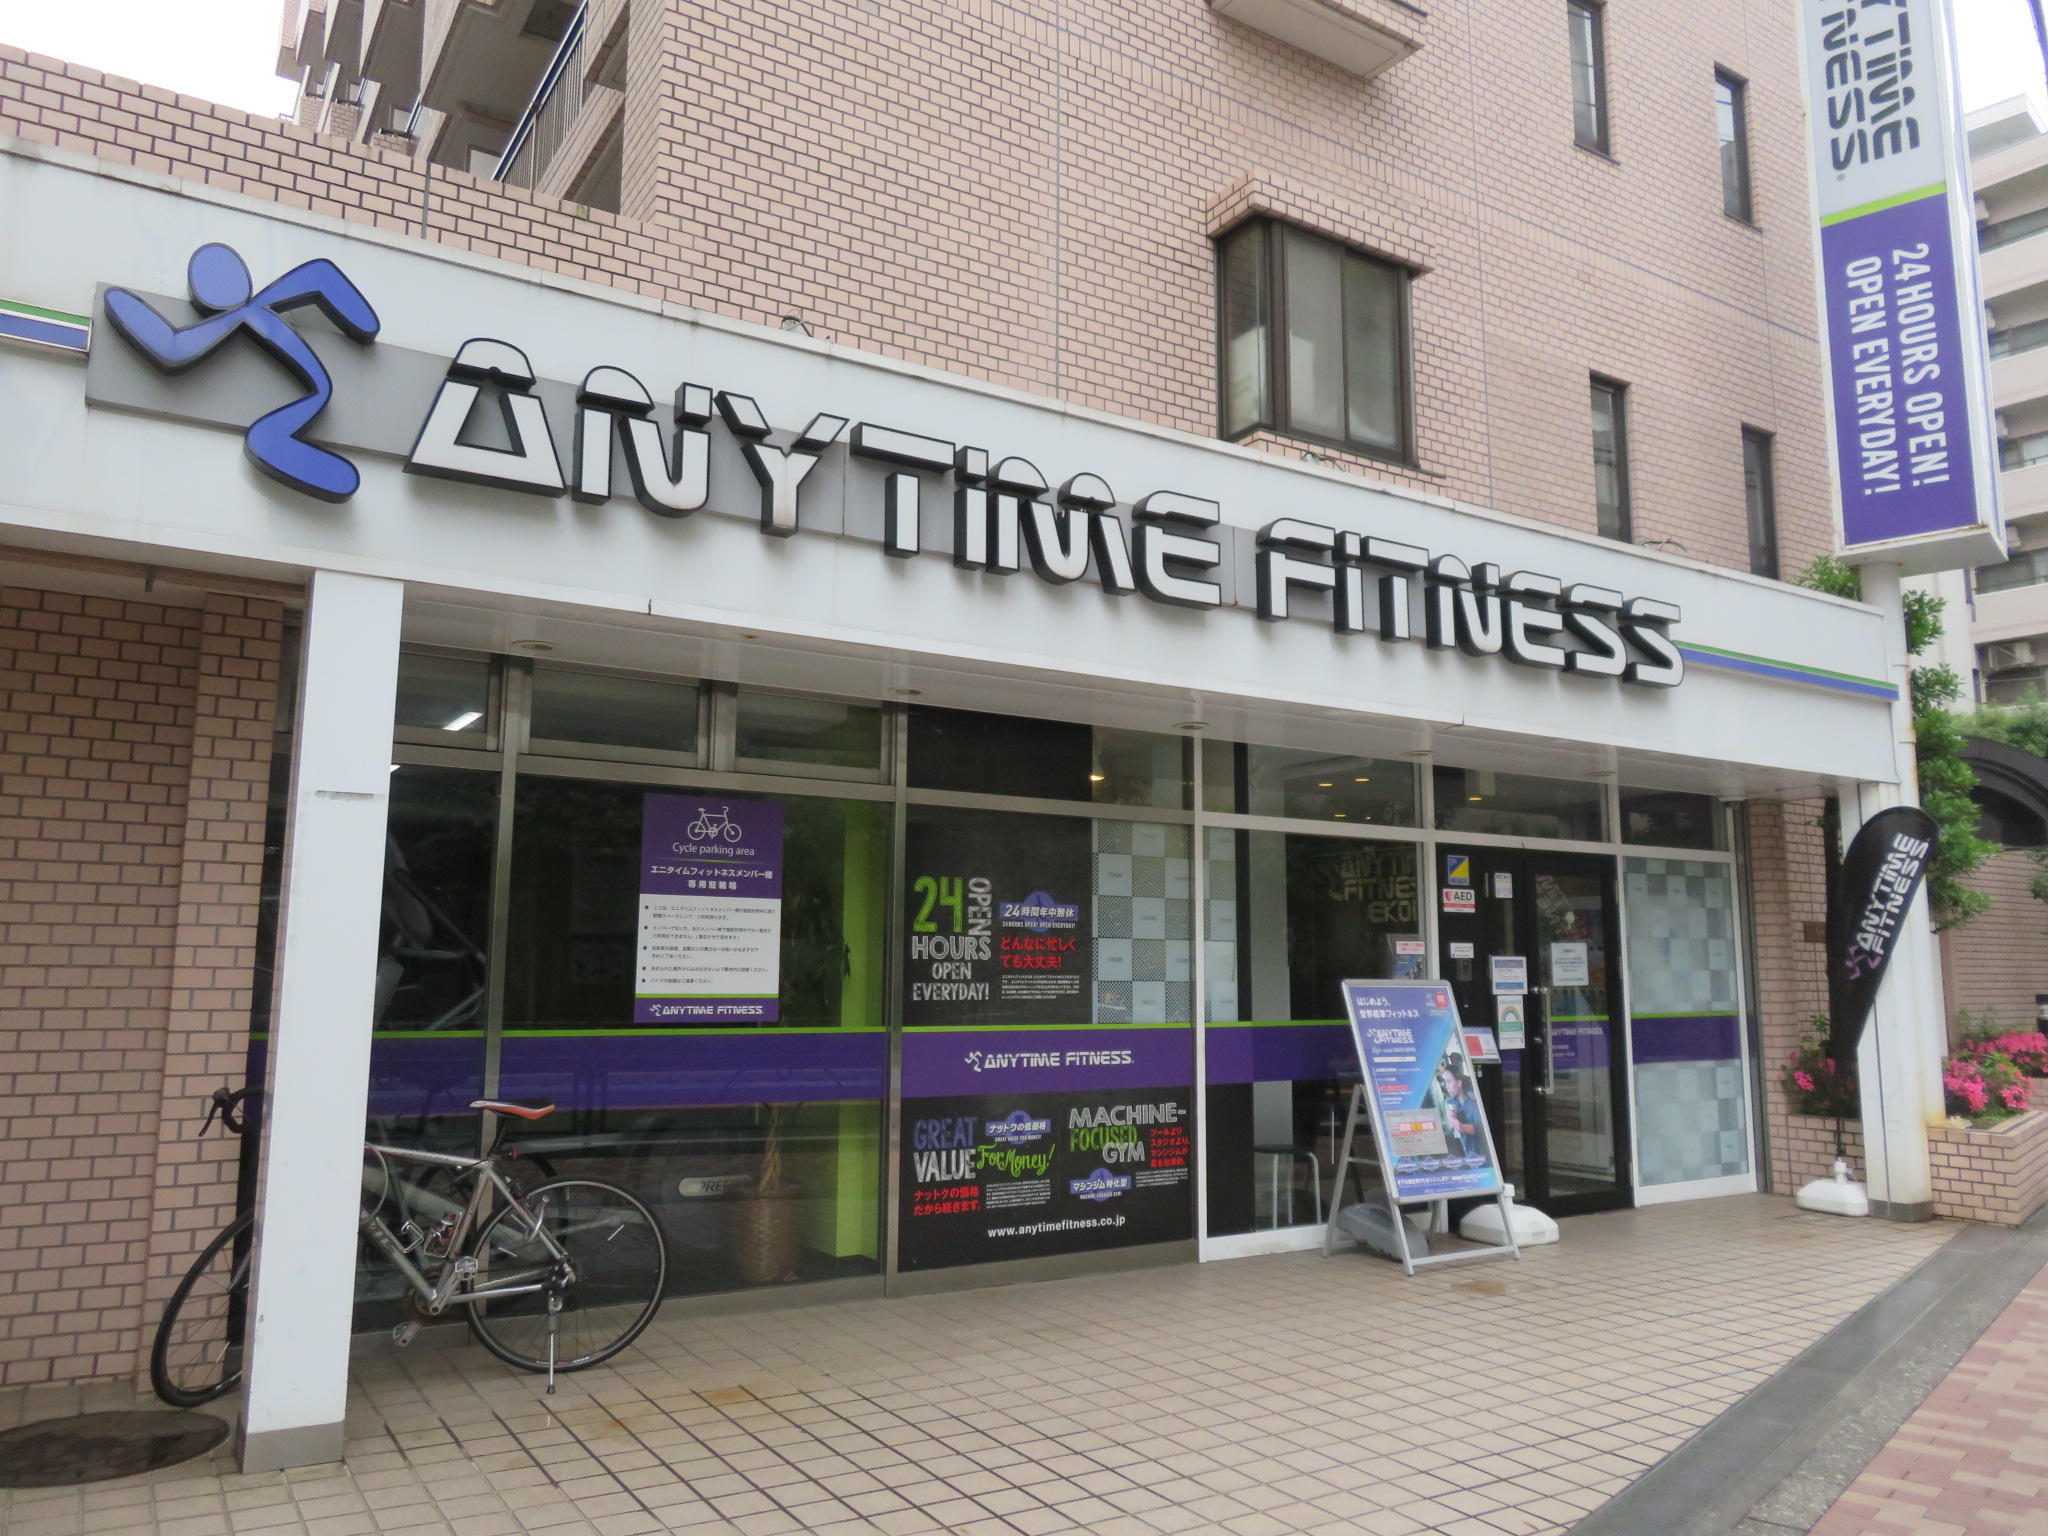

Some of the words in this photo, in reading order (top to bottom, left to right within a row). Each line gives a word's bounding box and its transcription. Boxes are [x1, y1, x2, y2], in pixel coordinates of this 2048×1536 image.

[1821, 0, 1869, 171] NESS
[1861, 0, 1920, 160] TIME
[1892, 243, 1931, 281] 24
[1846, 256, 1887, 334] OPEN
[1896, 281, 1941, 385] HOURS
[1852, 337, 1901, 496] EVERYDAY!
[1905, 391, 1950, 487] OPEN!
[410, 337, 1221, 607] ANYTIME
[1256, 517, 1685, 687] FITNESS
[672, 842, 697, 855] Cycle
[699, 845, 734, 857] parking
[735, 847, 755, 856] area
[650, 865, 774, 879] エニタイムフィットネスメンバー様
[913, 876, 964, 933] 24
[1454, 891, 1472, 901] AED
[1857, 833, 1912, 951] ANYTIME
[1871, 840, 1929, 955] FITNESS
[968, 877, 992, 936] OPEN
[1004, 904, 1075, 918] 24時間年中無休
[911, 935, 992, 961] HOURS
[1000, 936, 1076, 951] どんなに忙しく
[931, 961, 972, 980] OPEN
[912, 982, 990, 1001] EVERYDAY!
[662, 1005, 714, 1015] ANYTIME
[717, 1005, 763, 1015] FITNESS
[1380, 1036, 1415, 1044] FITNESS
[984, 1052, 1061, 1069] ANYTIME
[1065, 1050, 1132, 1066] FITNESS
[989, 1121, 1047, 1134] ナットクの低価格
[1069, 1102, 1187, 1129] MACHINE-
[914, 1117, 977, 1149] GREAT
[1070, 1125, 1138, 1152] FOCUSED
[913, 1148, 977, 1183] VALUE
[976, 1143, 1003, 1170] For
[999, 1143, 1055, 1178] Money!
[1102, 1141, 1146, 1164] GYM
[914, 1185, 979, 1202] ナットクの価格
[988, 1215, 1126, 1238] www.anytimefitness.co.jp
